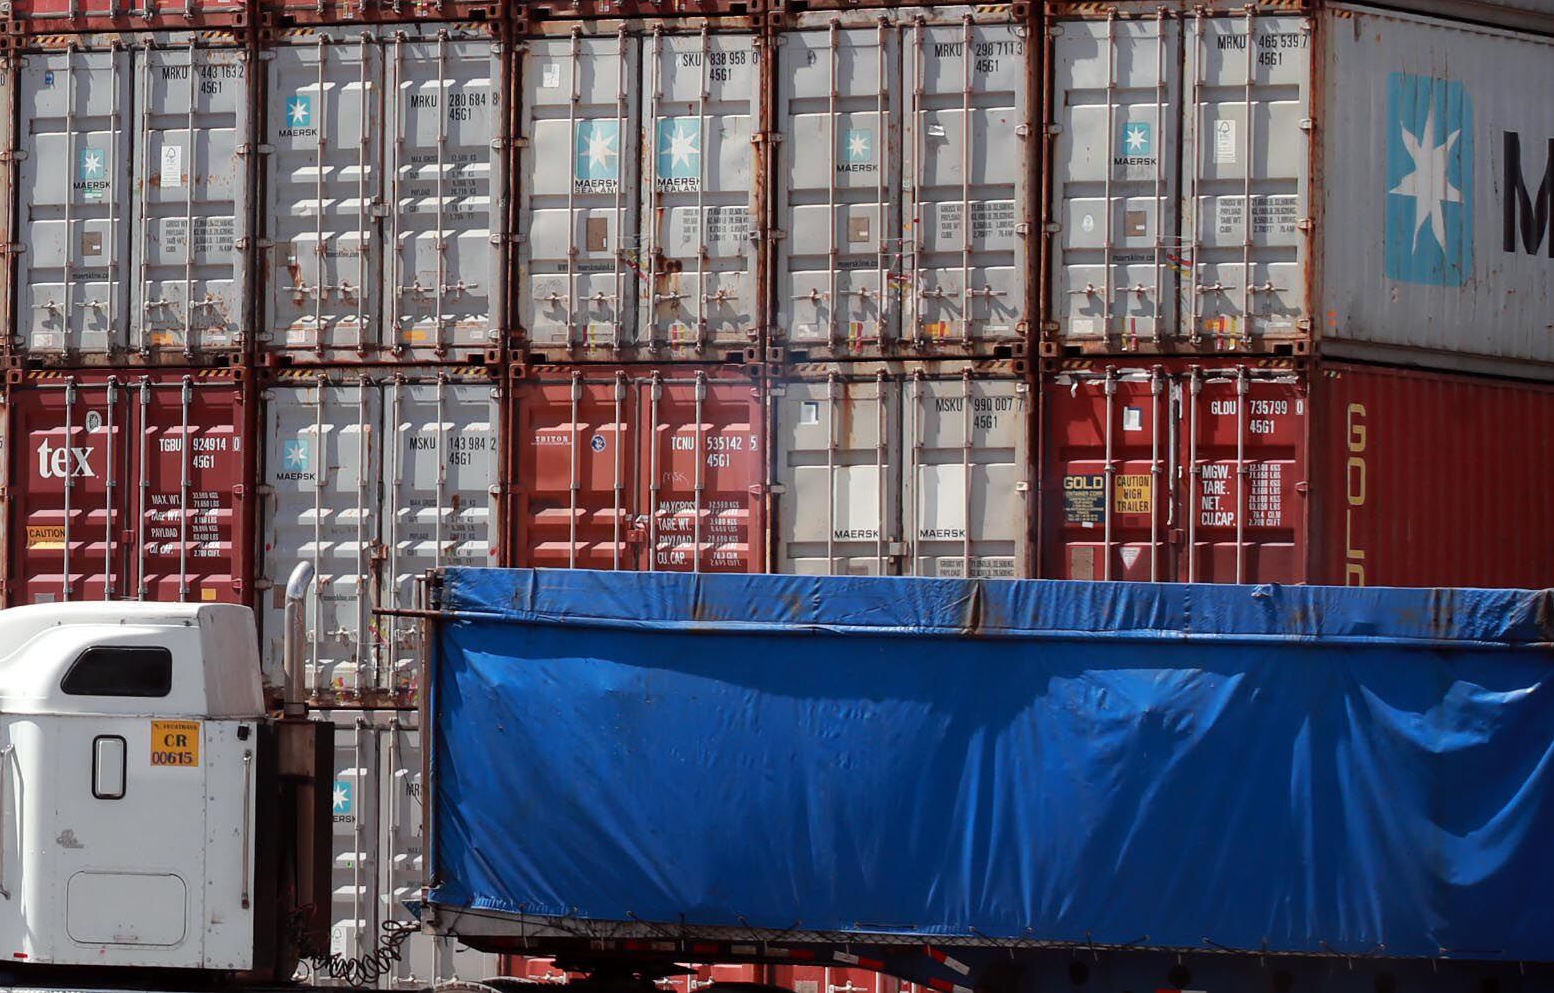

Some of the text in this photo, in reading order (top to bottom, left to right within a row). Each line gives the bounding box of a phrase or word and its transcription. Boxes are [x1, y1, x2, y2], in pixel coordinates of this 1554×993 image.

[278, 128, 317, 138] MAERSK
[1114, 157, 1157, 166] MAERSK
[836, 164, 878, 172] MAERSK
[73, 181, 111, 190] MAERSK
[36, 438, 96, 478] tex
[276, 472, 316, 480] MAERSK
[1116, 475, 1151, 487] CAUTION
[1063, 476, 1104, 489] GOLD
[1123, 489, 1142, 500] HIGH
[1116, 500, 1150, 512] TRAILER
[29, 529, 65, 538] CAUTION
[834, 529, 879, 539] MAERSK
[919, 529, 965, 538] MAERSK
[164, 734, 187, 747] CR
[152, 751, 192, 765] 00615
